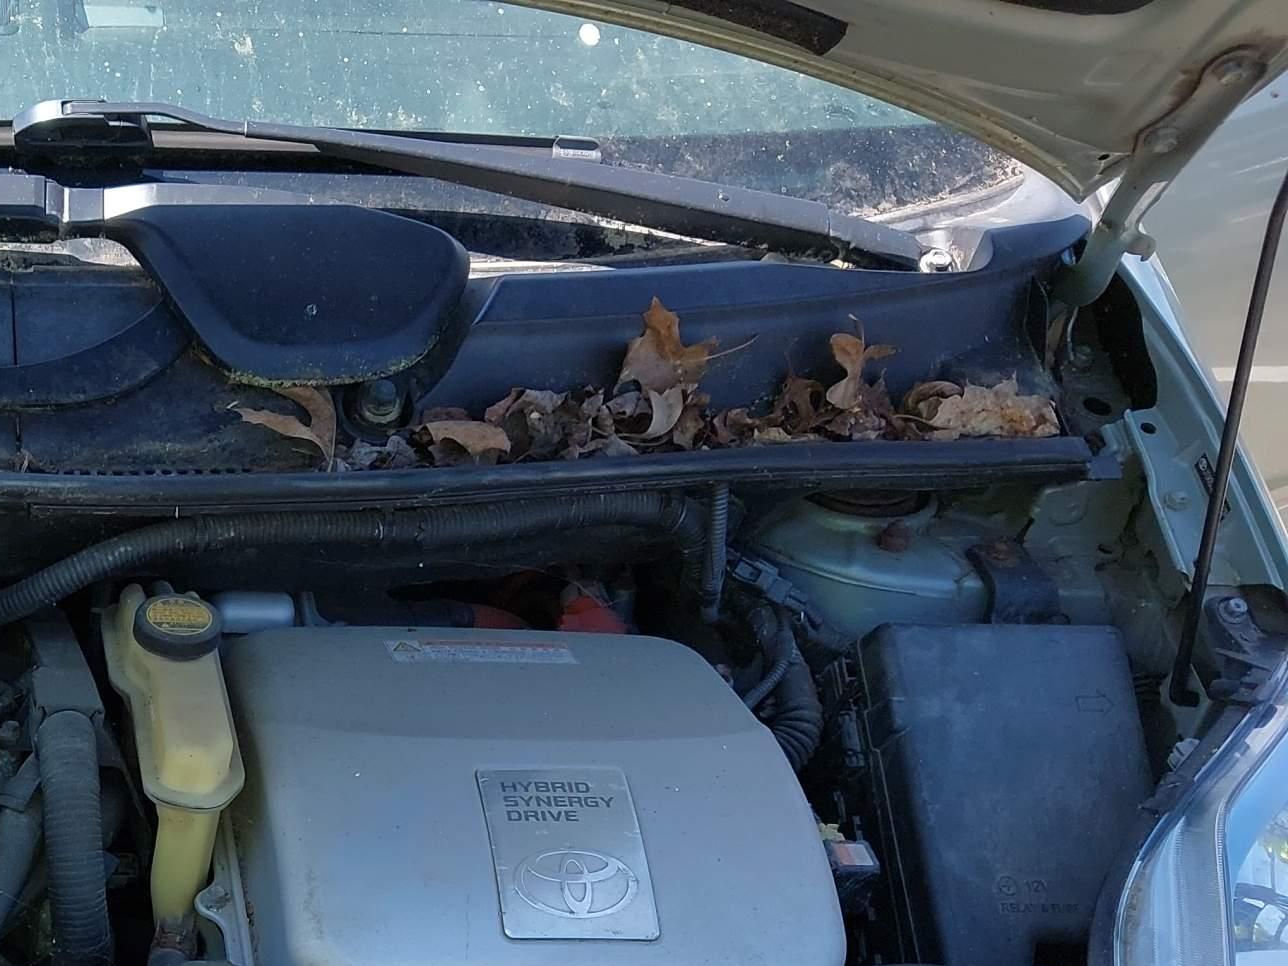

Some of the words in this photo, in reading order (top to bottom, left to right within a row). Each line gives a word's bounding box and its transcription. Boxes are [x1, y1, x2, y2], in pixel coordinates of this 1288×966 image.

[500, 781, 591, 794] HYBRID
[503, 795, 615, 809] SYNERGY
[506, 809, 580, 822] DRIVE
